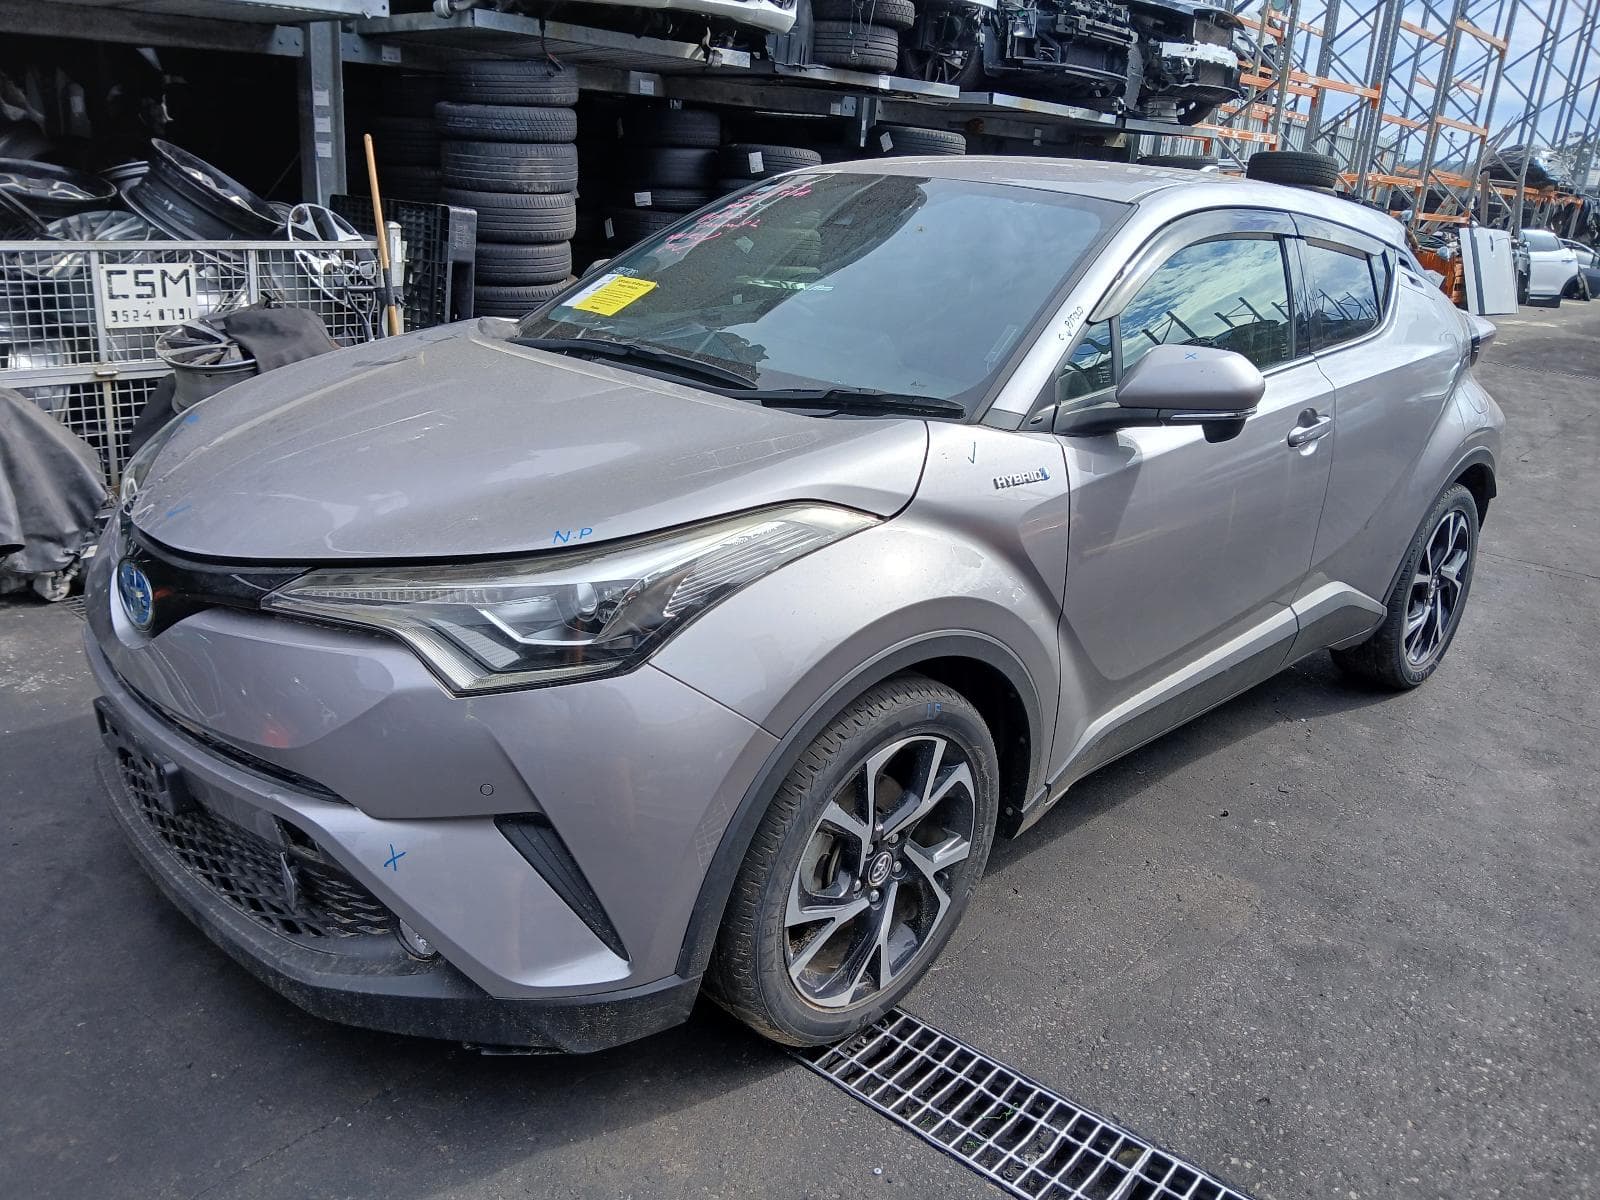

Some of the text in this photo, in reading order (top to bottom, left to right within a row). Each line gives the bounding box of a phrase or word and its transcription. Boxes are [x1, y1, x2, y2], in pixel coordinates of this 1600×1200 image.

[106, 269, 191, 299] CSM
[993, 470, 1043, 490] HYBRID
[553, 527, 593, 544] N.P
